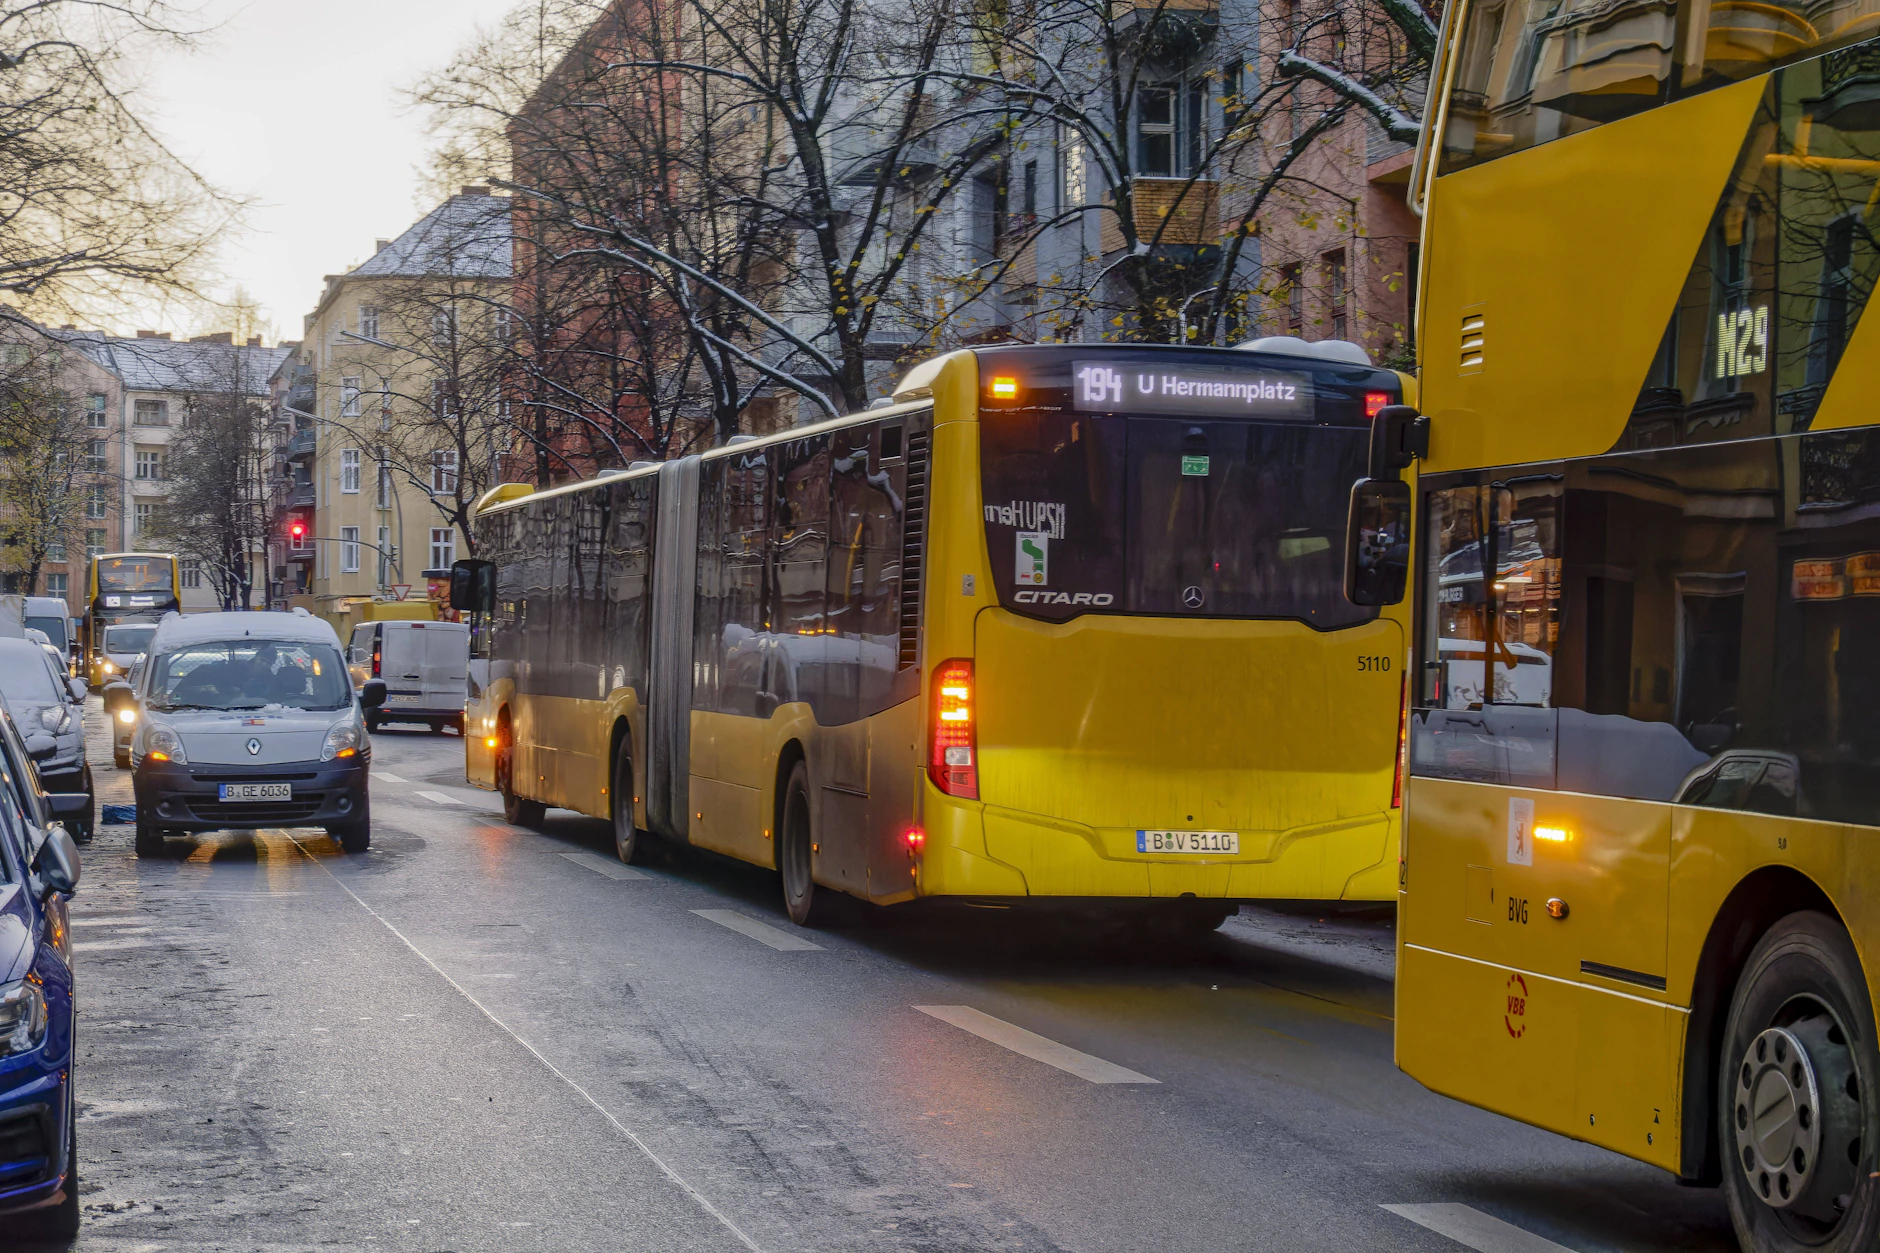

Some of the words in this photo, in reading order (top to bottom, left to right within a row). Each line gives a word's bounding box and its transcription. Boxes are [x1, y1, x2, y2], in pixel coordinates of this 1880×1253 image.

[1717, 305, 1768, 379] M29
[1077, 367, 1122, 403] 194
[1138, 374, 1154, 394] U
[1162, 376, 1296, 403] Hermannplatz
[1014, 591, 1114, 606] CITARO
[1357, 656, 1391, 672] 5110
[227, 786, 235, 797] B
[243, 786, 258, 797] GE
[261, 786, 290, 797] 6036
[1153, 833, 1164, 850] B
[1175, 833, 1186, 850] V
[1190, 833, 1231, 851] 5110
[1508, 896, 1529, 925] BVG
[1507, 995, 1526, 1017] VBB
